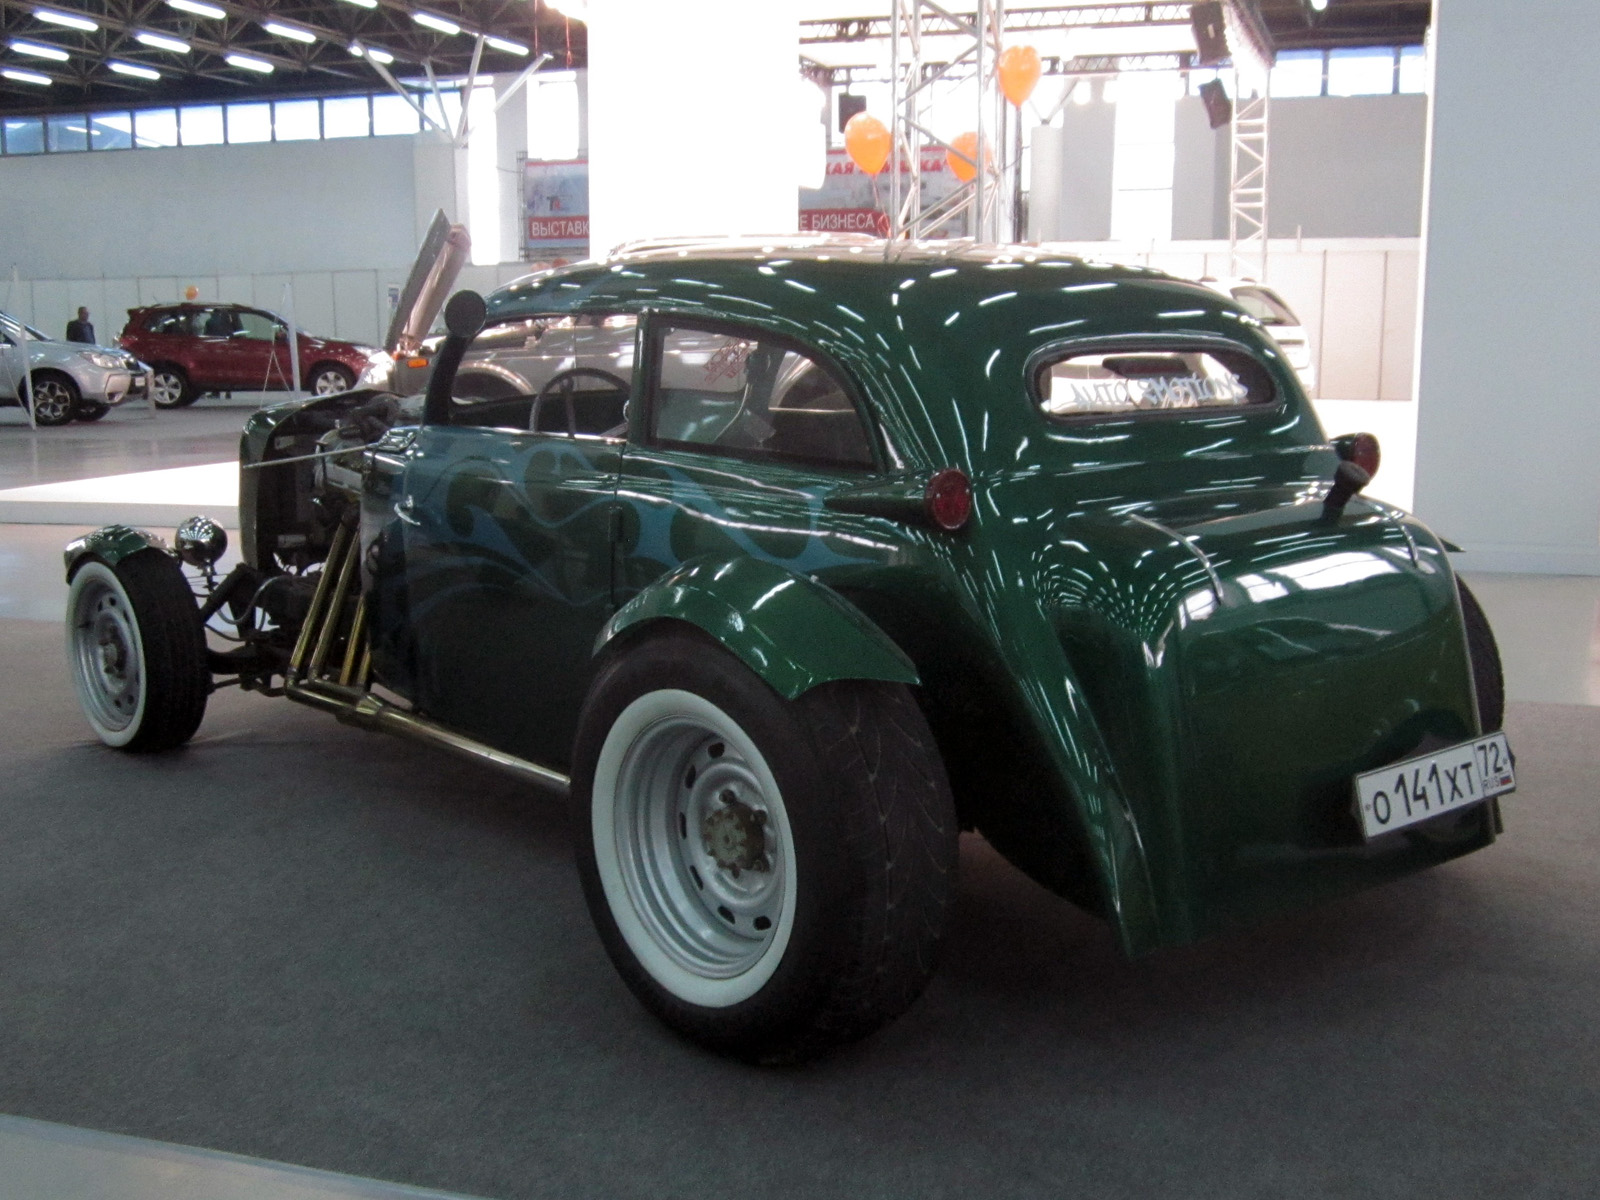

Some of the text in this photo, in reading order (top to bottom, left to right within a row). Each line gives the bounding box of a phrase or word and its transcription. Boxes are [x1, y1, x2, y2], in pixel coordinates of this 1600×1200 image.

[811, 213, 875, 230] БИЗНЕСА
[1070, 380, 1130, 408] AUTO
[1476, 741, 1504, 777] 72
